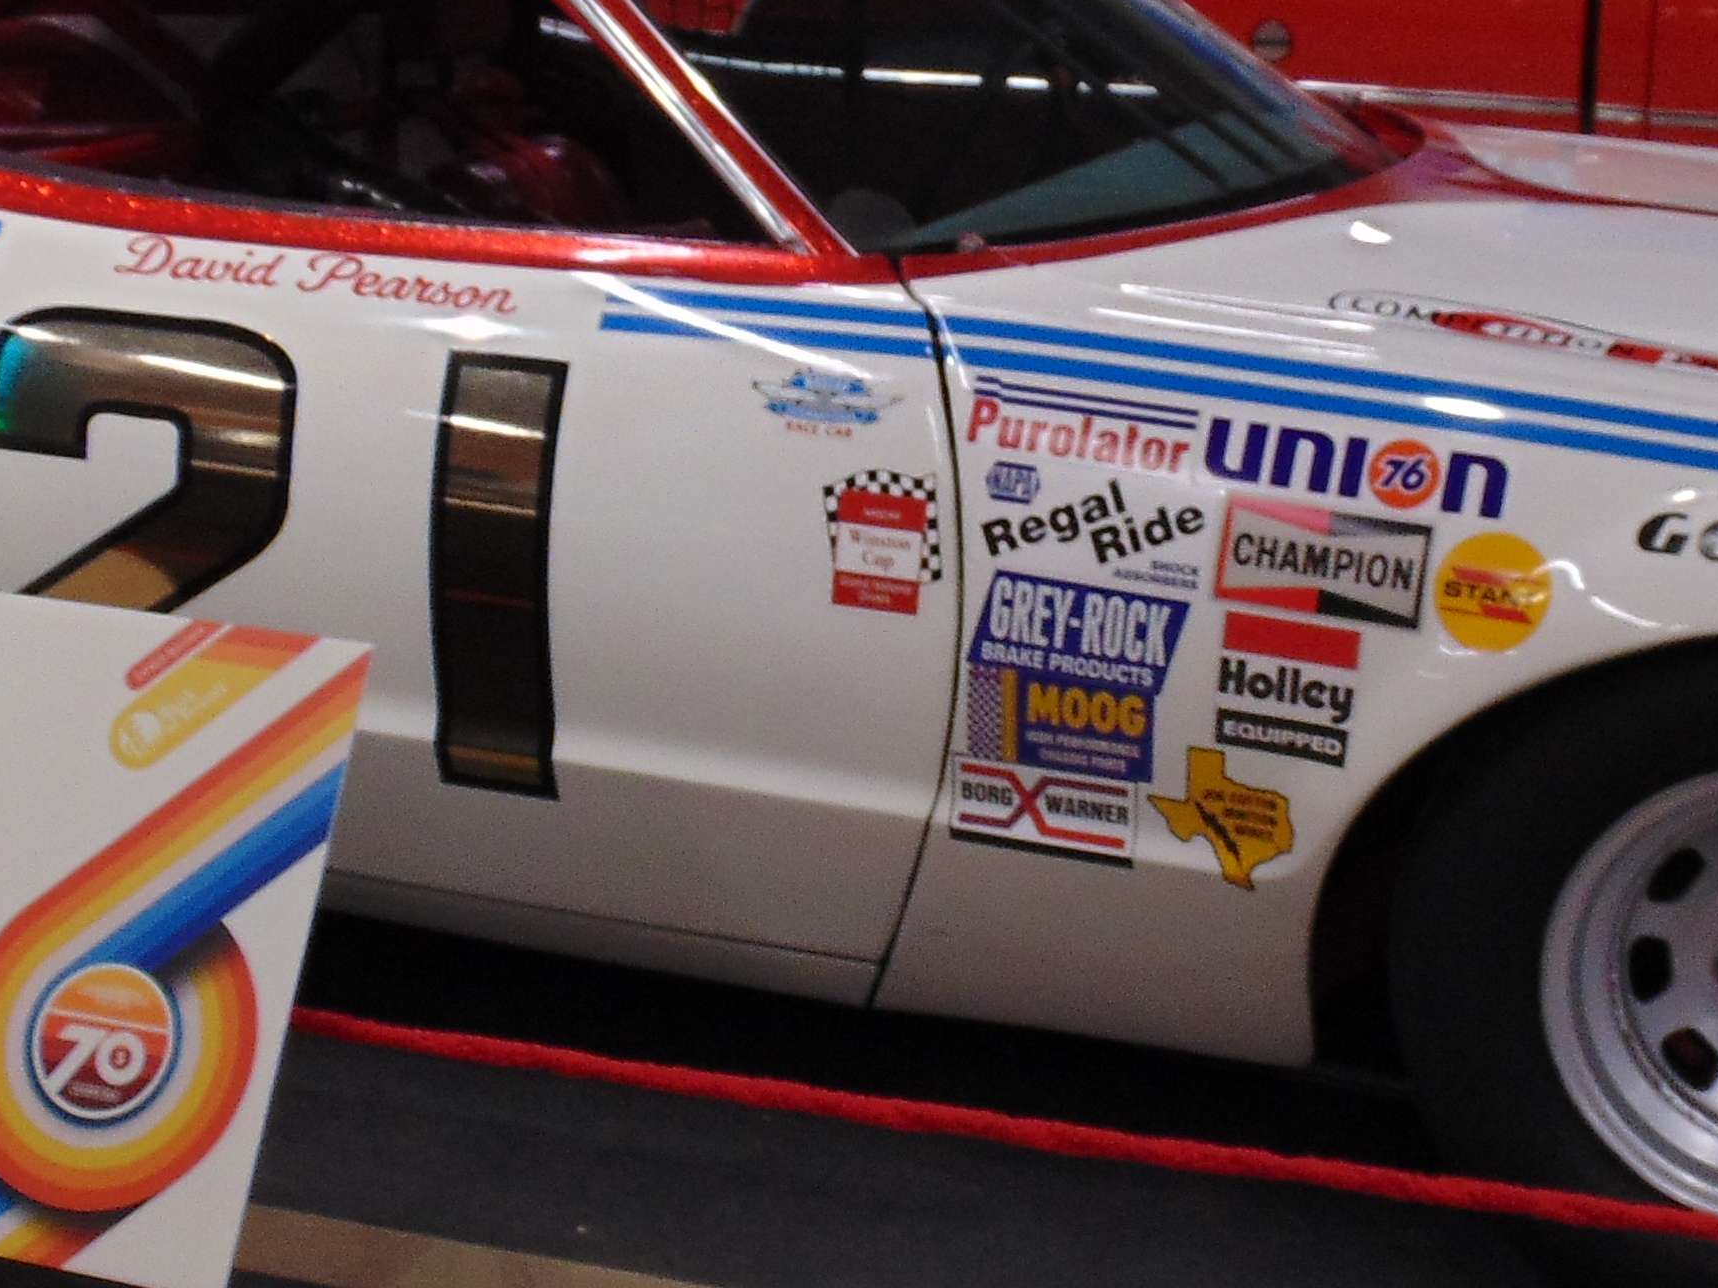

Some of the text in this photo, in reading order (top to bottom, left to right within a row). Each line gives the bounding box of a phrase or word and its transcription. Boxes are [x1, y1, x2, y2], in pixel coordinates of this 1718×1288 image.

[115, 234, 517, 315] David Pearson
[966, 396, 1191, 474] Purolator
[1382, 456, 1430, 492] 76
[982, 479, 1129, 560] Regal
[1089, 504, 1206, 566] Ride
[1232, 532, 1417, 594] CHAMPION
[989, 574, 1172, 667] GREY-ROCK
[981, 639, 1155, 689] BRAKE PRODUCTS
[1218, 656, 1356, 725] Holley
[1025, 681, 1150, 740] MOOG
[1221, 719, 1344, 758] EQUIPPED
[960, 779, 1130, 827] BORG WARNER
